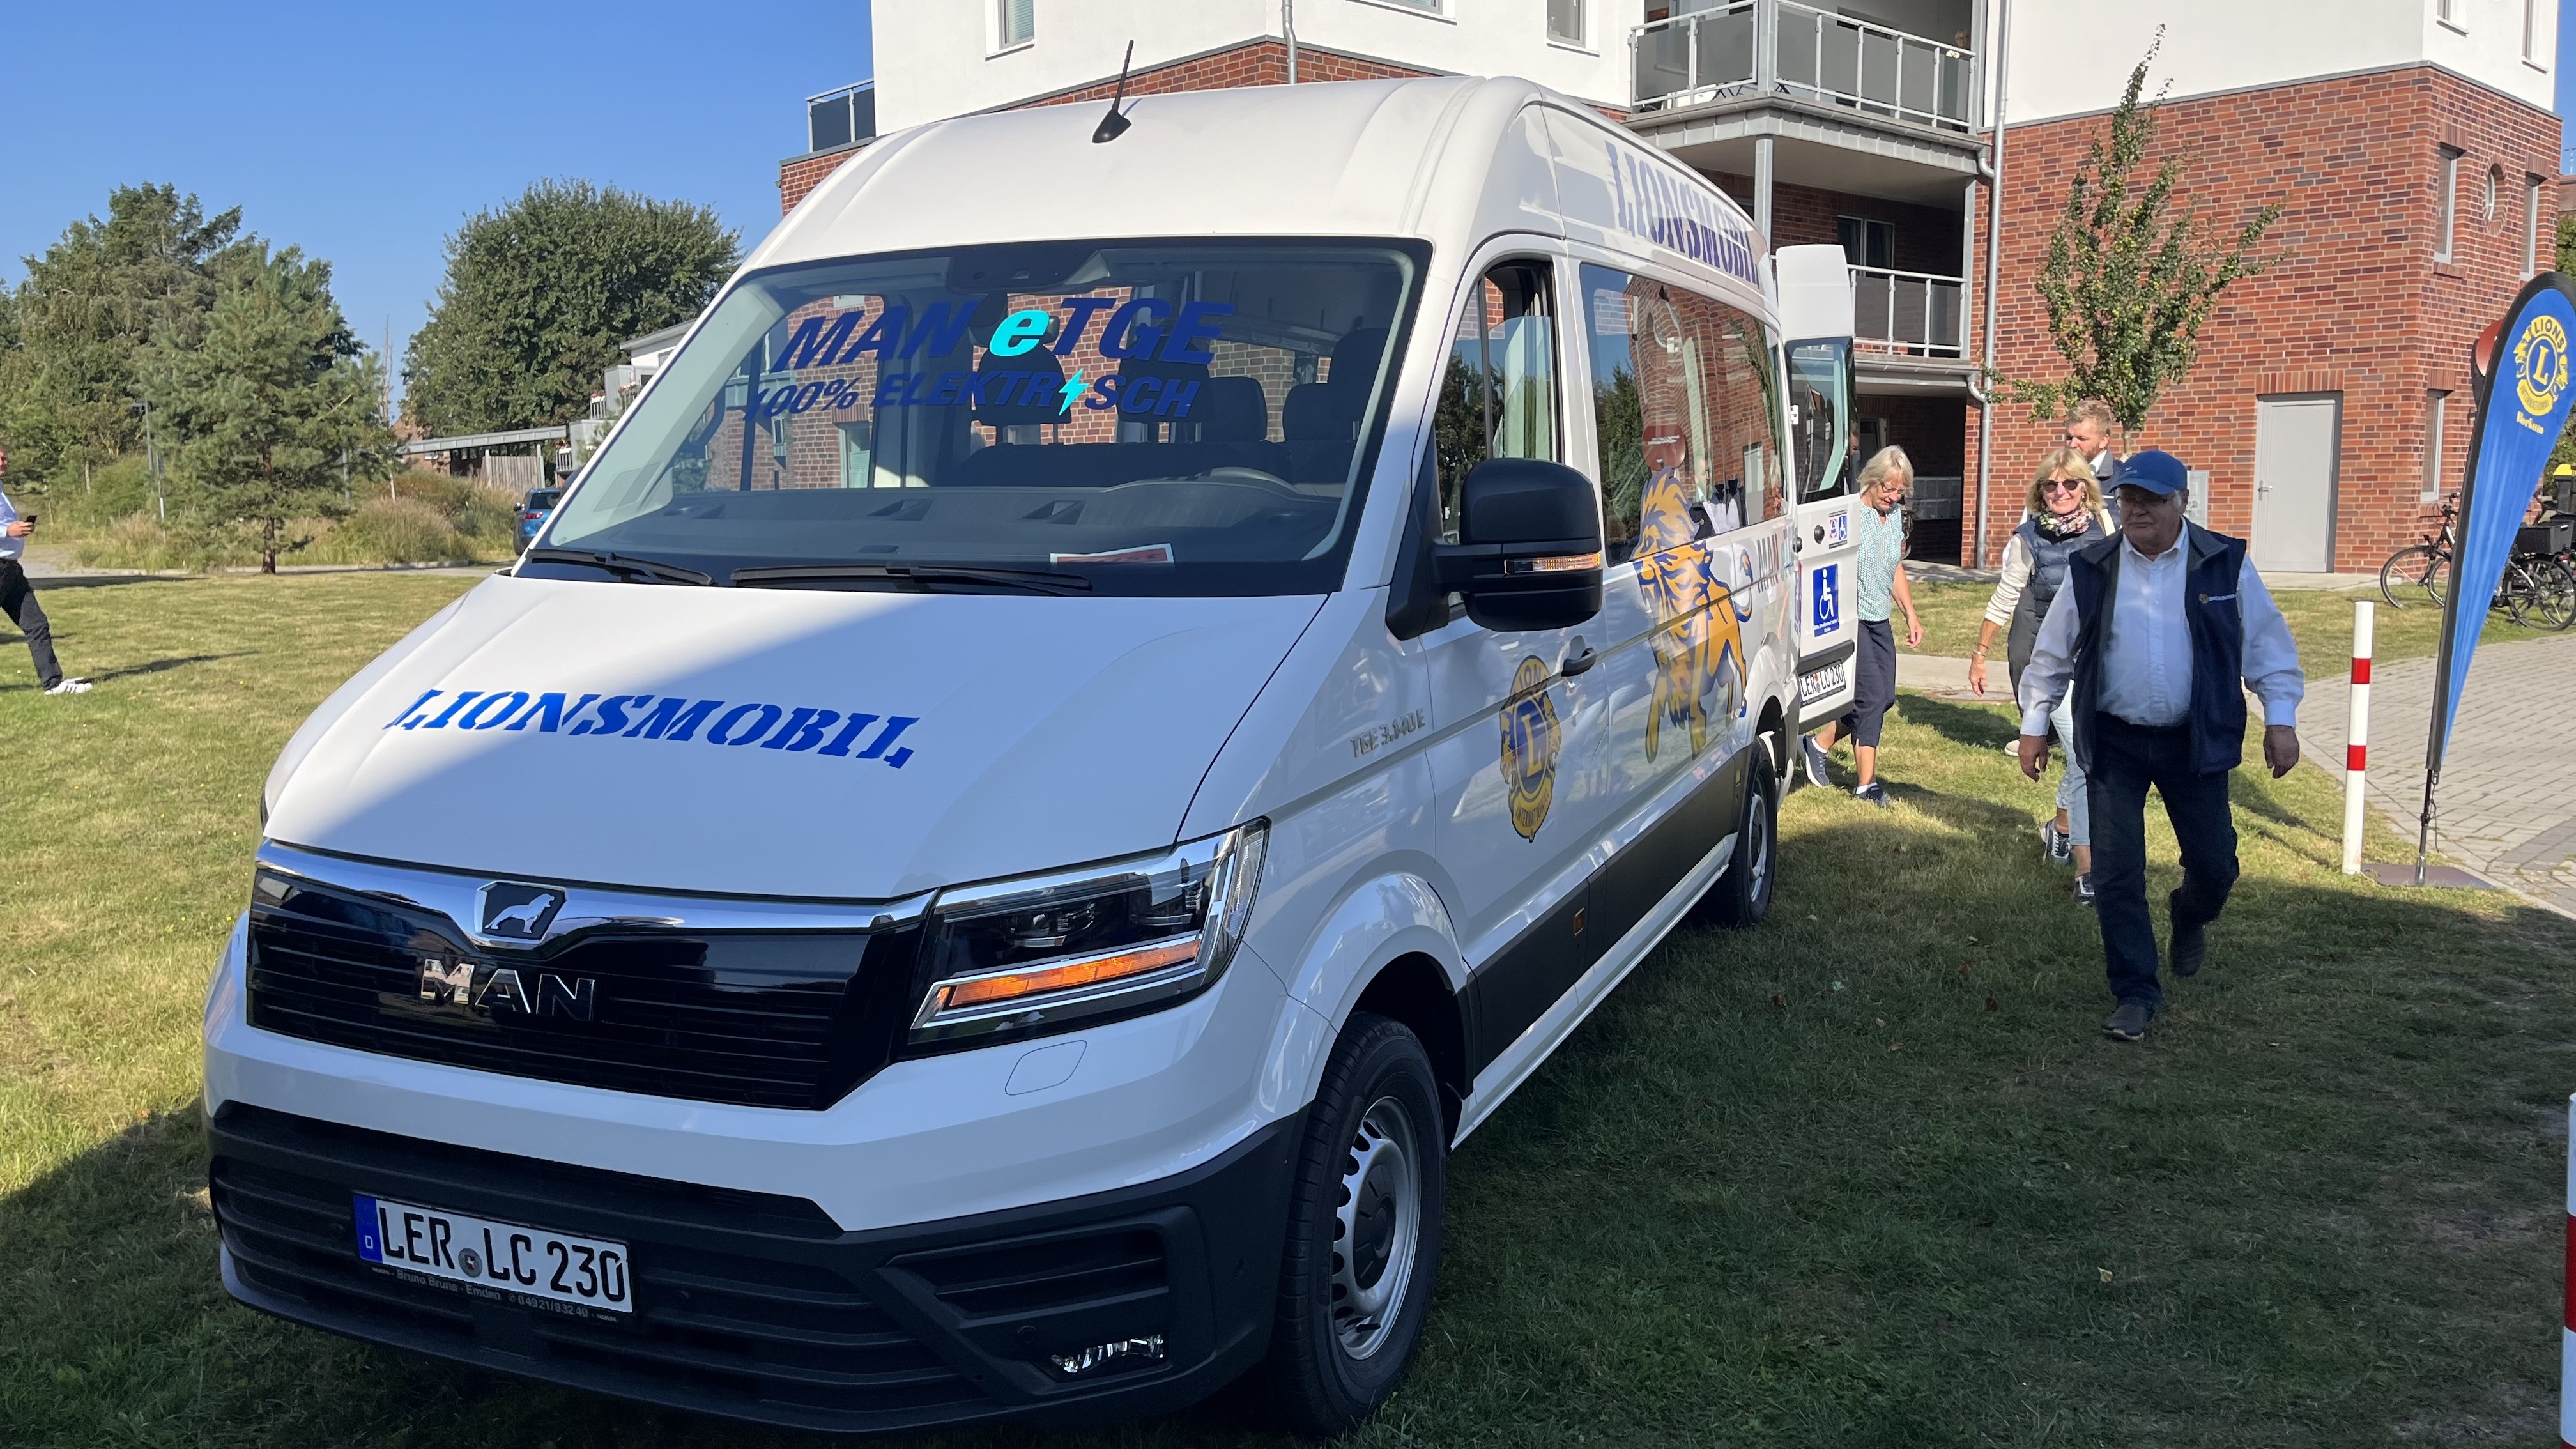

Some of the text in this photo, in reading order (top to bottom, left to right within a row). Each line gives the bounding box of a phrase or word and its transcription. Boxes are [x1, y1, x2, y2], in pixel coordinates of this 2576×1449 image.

[1604, 140, 1760, 289] LIONSMOBIL
[771, 297, 1236, 372] MAN eTGE
[2534, 319, 2564, 349] LIONS
[2533, 345, 2549, 385] L
[744, 376, 862, 420] 100%
[1800, 674, 1817, 697] LER
[1820, 668, 1832, 689] LC
[1832, 664, 1844, 686] 230
[382, 689, 919, 769] LIONSMOBIL
[1349, 728, 1379, 758] TGE
[1521, 714, 1542, 778] L
[1515, 788, 1550, 828] INTERNATIONAL
[420, 958, 596, 1022] MAN
[364, 1234, 373, 1250] D
[379, 1207, 626, 1302] LER LC 230
[397, 1268, 426, 1284] Bruno
[428, 1275, 458, 1291] Bruns
[465, 1284, 501, 1300] Emden
